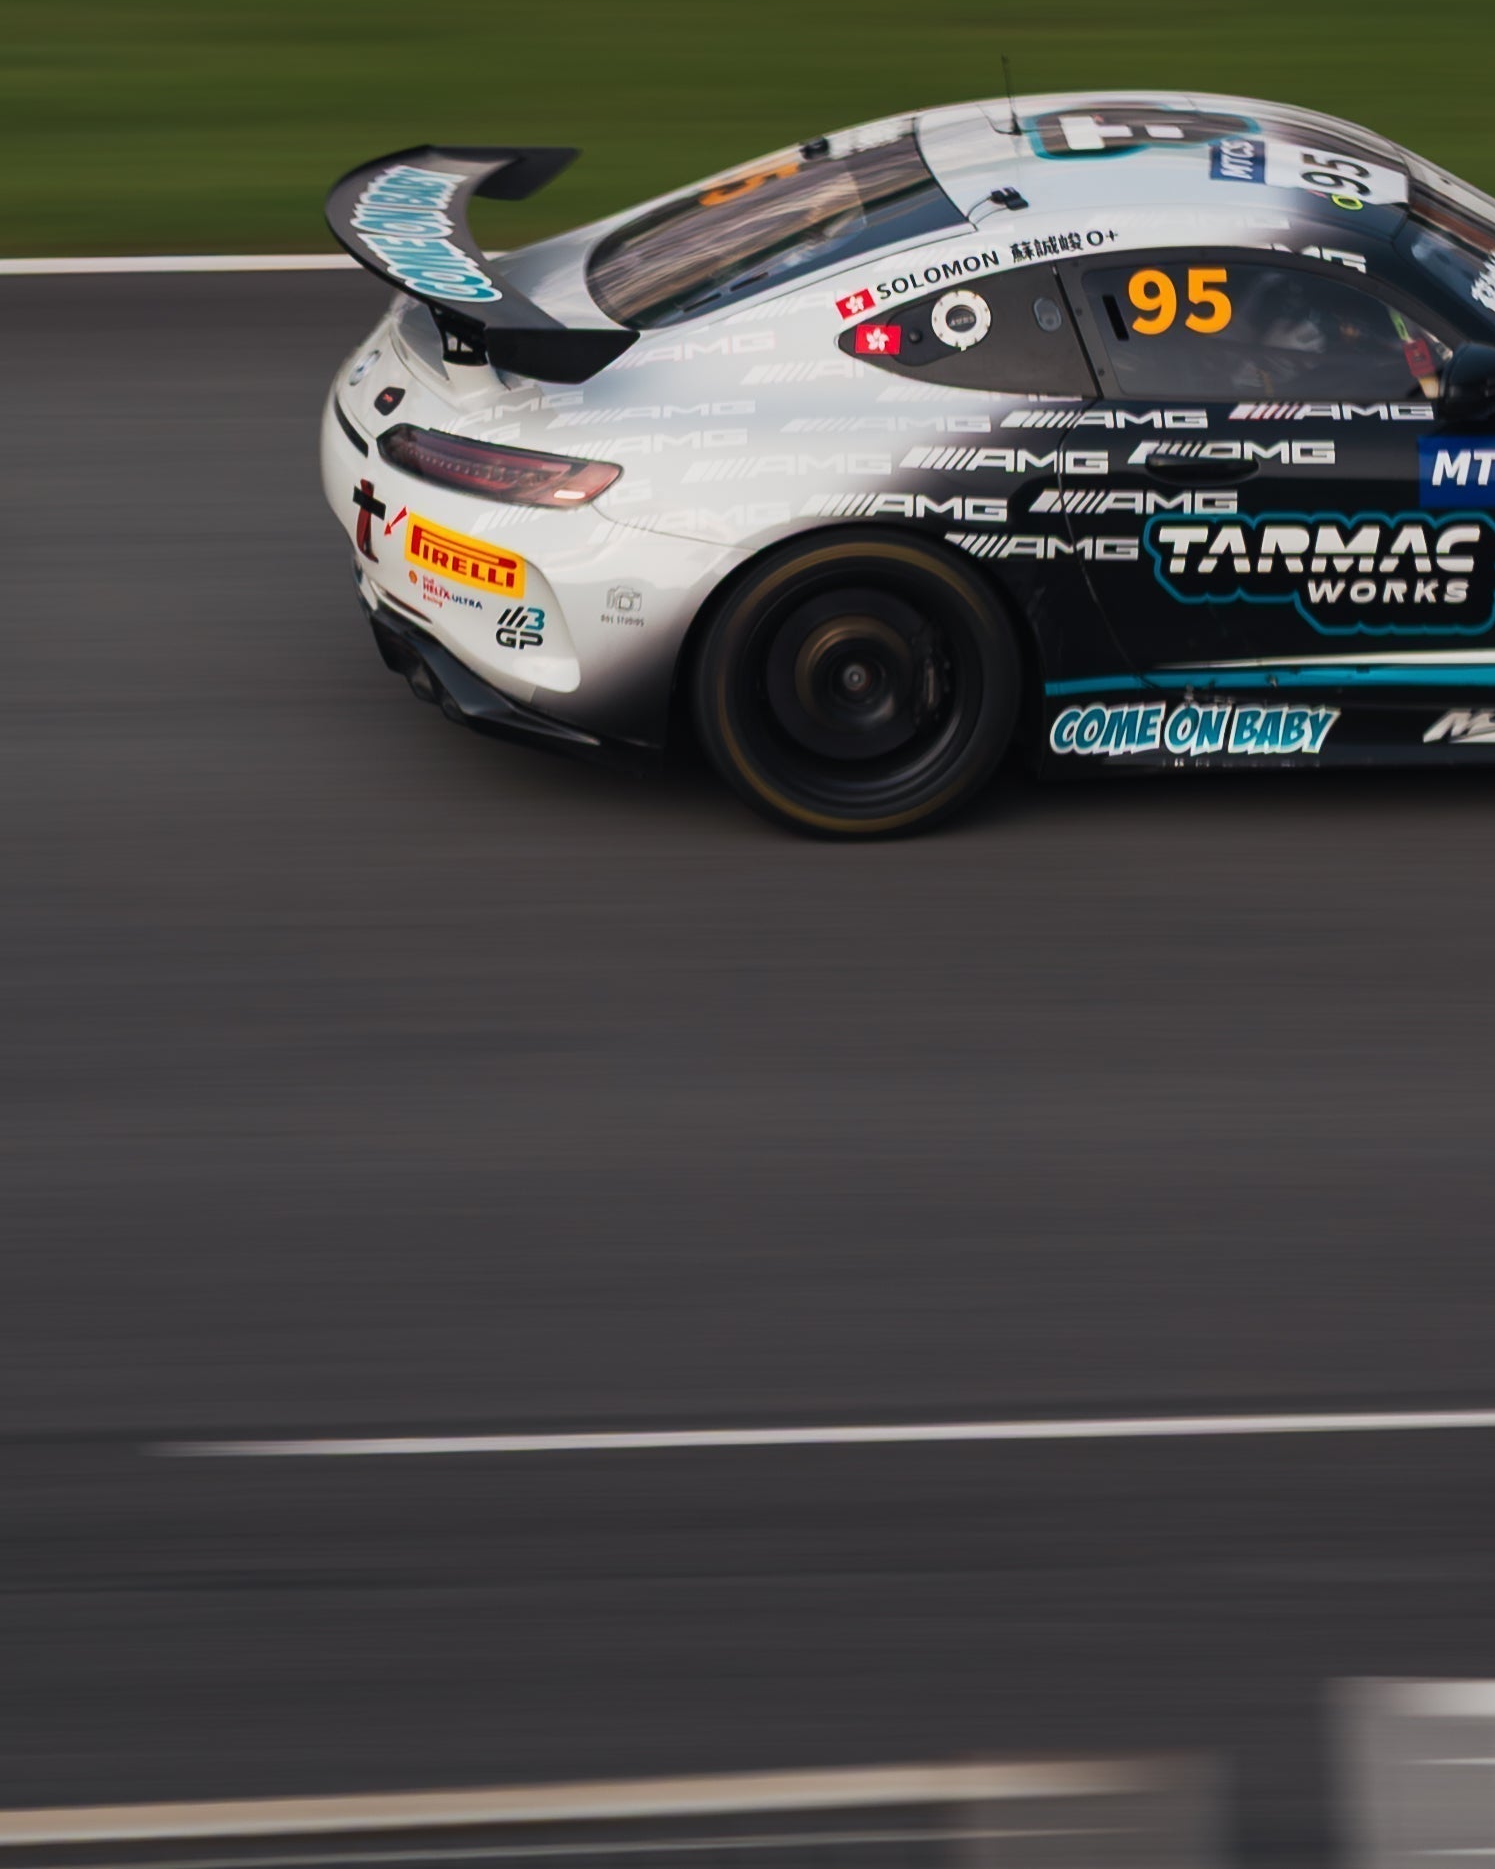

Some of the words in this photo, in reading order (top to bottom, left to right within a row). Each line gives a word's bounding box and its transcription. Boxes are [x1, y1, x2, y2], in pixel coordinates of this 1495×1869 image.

[1219, 138, 1255, 179] MTCS
[1301, 153, 1371, 195] 95
[351, 204, 455, 238] ON
[358, 233, 503, 302] COME
[876, 250, 1000, 300] SOLOMON
[1127, 267, 1232, 335] 95
[639, 330, 775, 367] AMG
[614, 400, 756, 421] AMG
[847, 415, 991, 432] AMG
[1073, 409, 1208, 429] AMG
[1294, 402, 1435, 421] AMG
[609, 428, 749, 458] AMG
[742, 453, 892, 479] AMG
[965, 447, 1109, 474] AMG
[647, 501, 791, 531] AMG
[866, 493, 1008, 522] AMG
[1095, 490, 1238, 515] AMG
[410, 524, 518, 588] PIRELLI
[998, 536, 1139, 561] AMG
[1158, 525, 1481, 574] TARMAC
[1307, 579, 1470, 604] WORKS
[495, 627, 543, 650] GP
[1050, 701, 1166, 756] COME
[1163, 701, 1231, 756] ON
[1227, 703, 1341, 755] BABY
